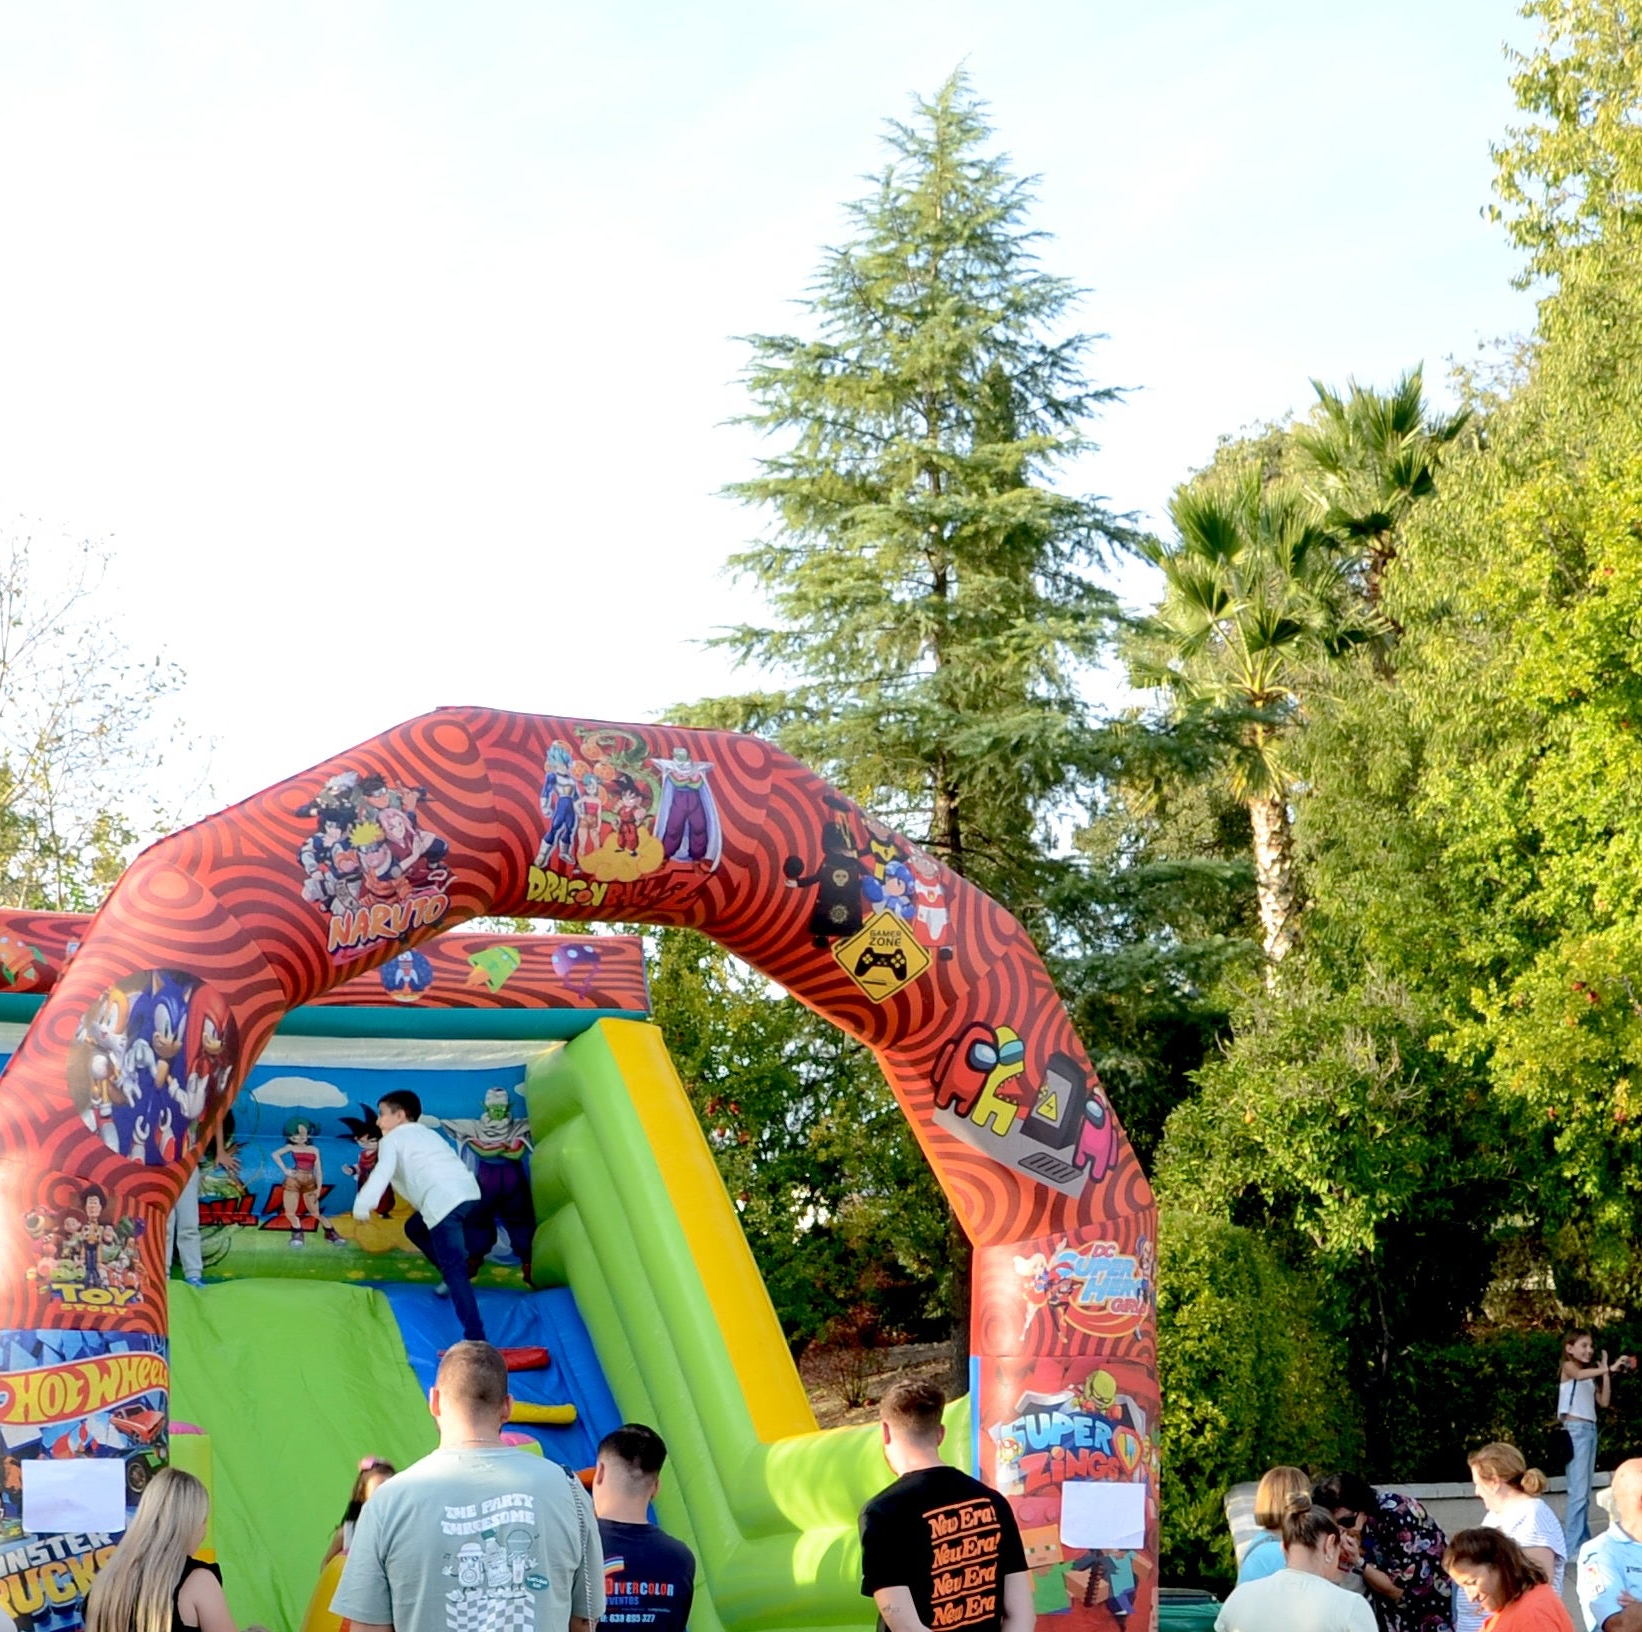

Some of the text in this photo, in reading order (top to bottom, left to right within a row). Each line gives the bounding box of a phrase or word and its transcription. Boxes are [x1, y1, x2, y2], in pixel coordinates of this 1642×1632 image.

[527, 865, 607, 907] DRAGON
[327, 894, 450, 952] NARUTO
[870, 929, 902, 938] GAMER
[869, 938, 901, 947] ZONE
[1092, 1244, 1117, 1257] DC
[51, 1283, 137, 1306] TOY
[60, 1303, 128, 1316] STORY
[1001, 1411, 1113, 1463] SUPER
[444, 1492, 534, 1520] THE PARTY
[441, 1509, 535, 1536] THREESOME
